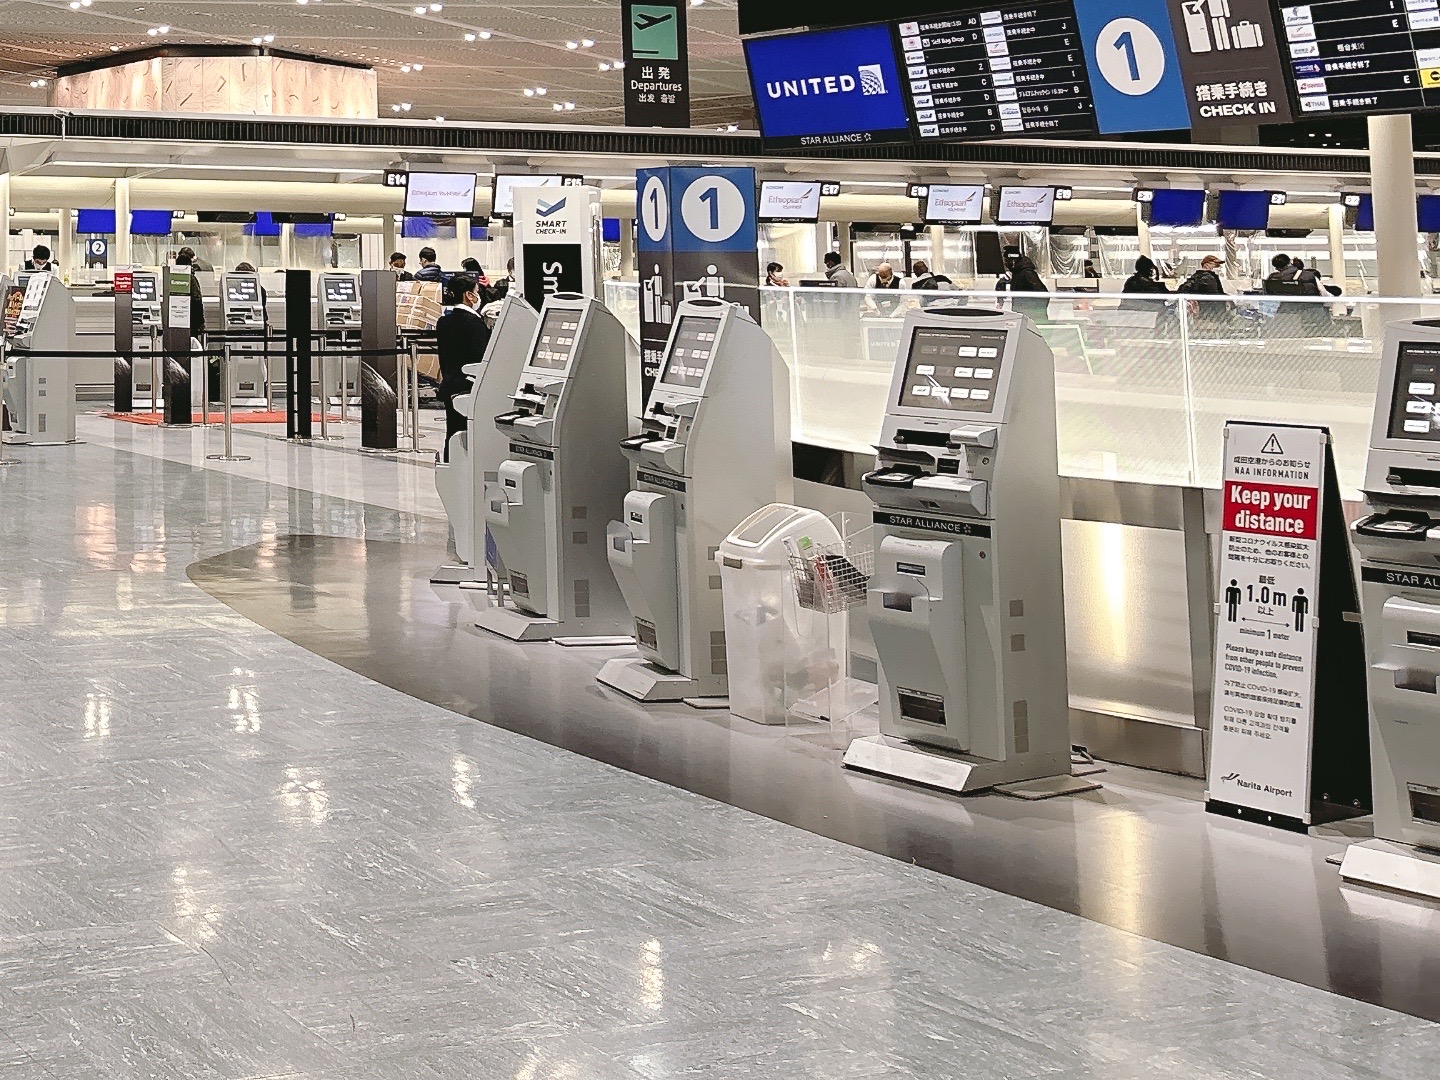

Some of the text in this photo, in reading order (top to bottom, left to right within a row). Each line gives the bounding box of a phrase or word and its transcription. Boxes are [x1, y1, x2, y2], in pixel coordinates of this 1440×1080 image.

[1061, 22, 1067, 30] J
[1391, 18, 1399, 28] E
[1113, 31, 1140, 82] 1
[642, 65, 671, 80] 出発
[631, 79, 682, 92] Departures
[1403, 75, 1411, 84] E
[766, 74, 856, 99] UNITED
[1195, 80, 1268, 102] 搭乗手続き
[1199, 101, 1276, 118] CHECK IN
[800, 133, 863, 145] STAR ALLIANCE
[387, 173, 407, 186] E14
[564, 177, 583, 187] E15
[822, 184, 839, 195] E17
[768, 196, 803, 205] Ethiopian
[934, 198, 967, 208] Ethiopian
[1006, 200, 1038, 209] Ethiopian
[650, 187, 658, 230] 1
[699, 187, 719, 230] 1
[535, 220, 567, 228] SMART
[95, 242, 102, 252] 2
[644, 348, 664, 364] 搭乗手
[644, 367, 660, 378] CHE
[1233, 456, 1311, 469] 成田空港からのお知らせ
[1234, 466, 1310, 480] NAA INFORMATION
[1231, 484, 1312, 511] Keep your
[889, 515, 961, 532] STAR ALLIANCE
[1234, 510, 1305, 535] distance
[1259, 574, 1276, 585] 最低
[1386, 571, 1420, 586] STAR
[1257, 606, 1274, 616] 以上
[1240, 627, 1265, 637] minimum
[1266, 629, 1271, 639] 1
[1225, 643, 1244, 652] Please
[1245, 647, 1259, 656] keep
[1264, 650, 1277, 658] safe
[1278, 652, 1302, 662] distance
[1224, 663, 1278, 678] COVID-19 infection.
[1240, 656, 1254, 664] other
[1255, 659, 1274, 668] people
[1282, 663, 1304, 672] prevent
[1247, 683, 1277, 694] COVID-19
[1223, 705, 1253, 716] COVID-19
[1236, 778, 1293, 798] Narita Airport
